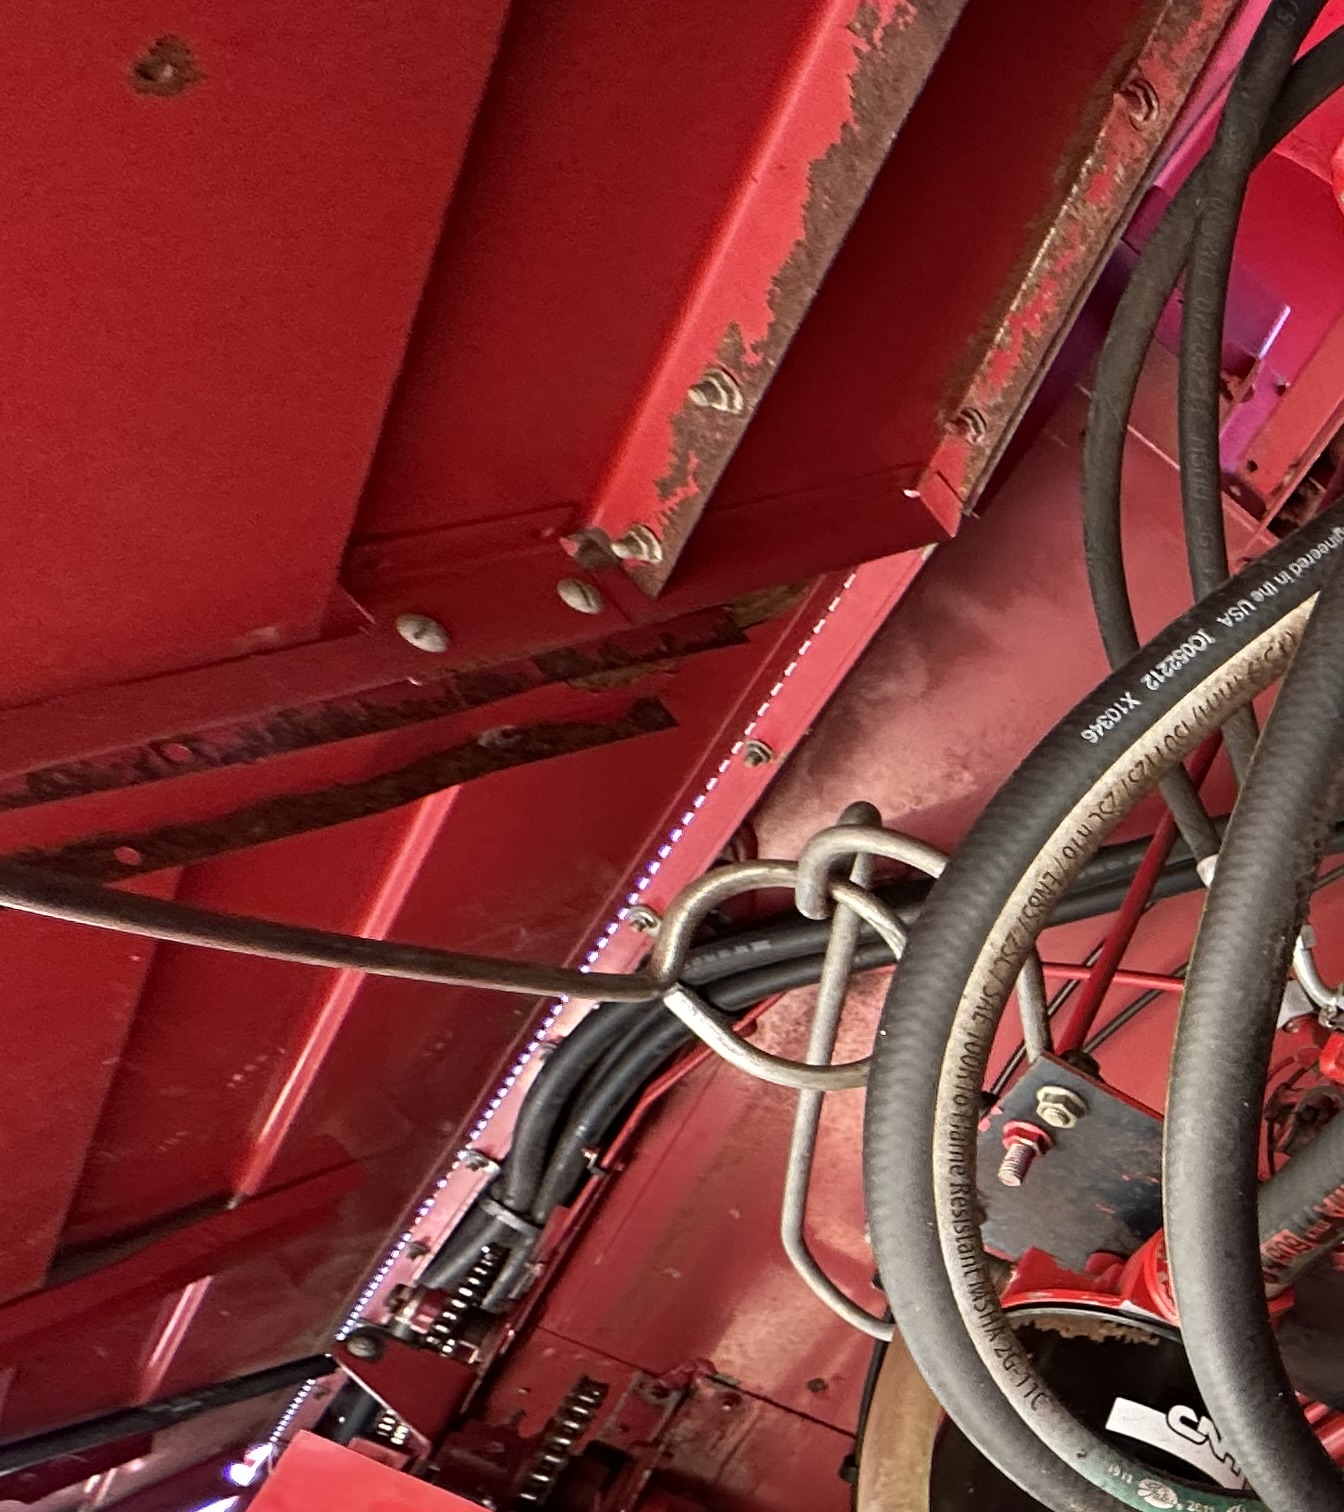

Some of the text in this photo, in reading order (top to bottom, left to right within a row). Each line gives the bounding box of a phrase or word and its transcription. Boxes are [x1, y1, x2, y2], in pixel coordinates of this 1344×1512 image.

[1250, 581, 1279, 602] the
[1273, 570, 1296, 585] in
[1216, 599, 1258, 628] USA
[1080, 691, 1142, 744] X10346
[973, 984, 996, 1027] SAE
[949, 1179, 984, 1279] Resistant
[968, 1279, 1006, 1342] MSHA
[993, 1340, 1048, 1412] 2G-11C
